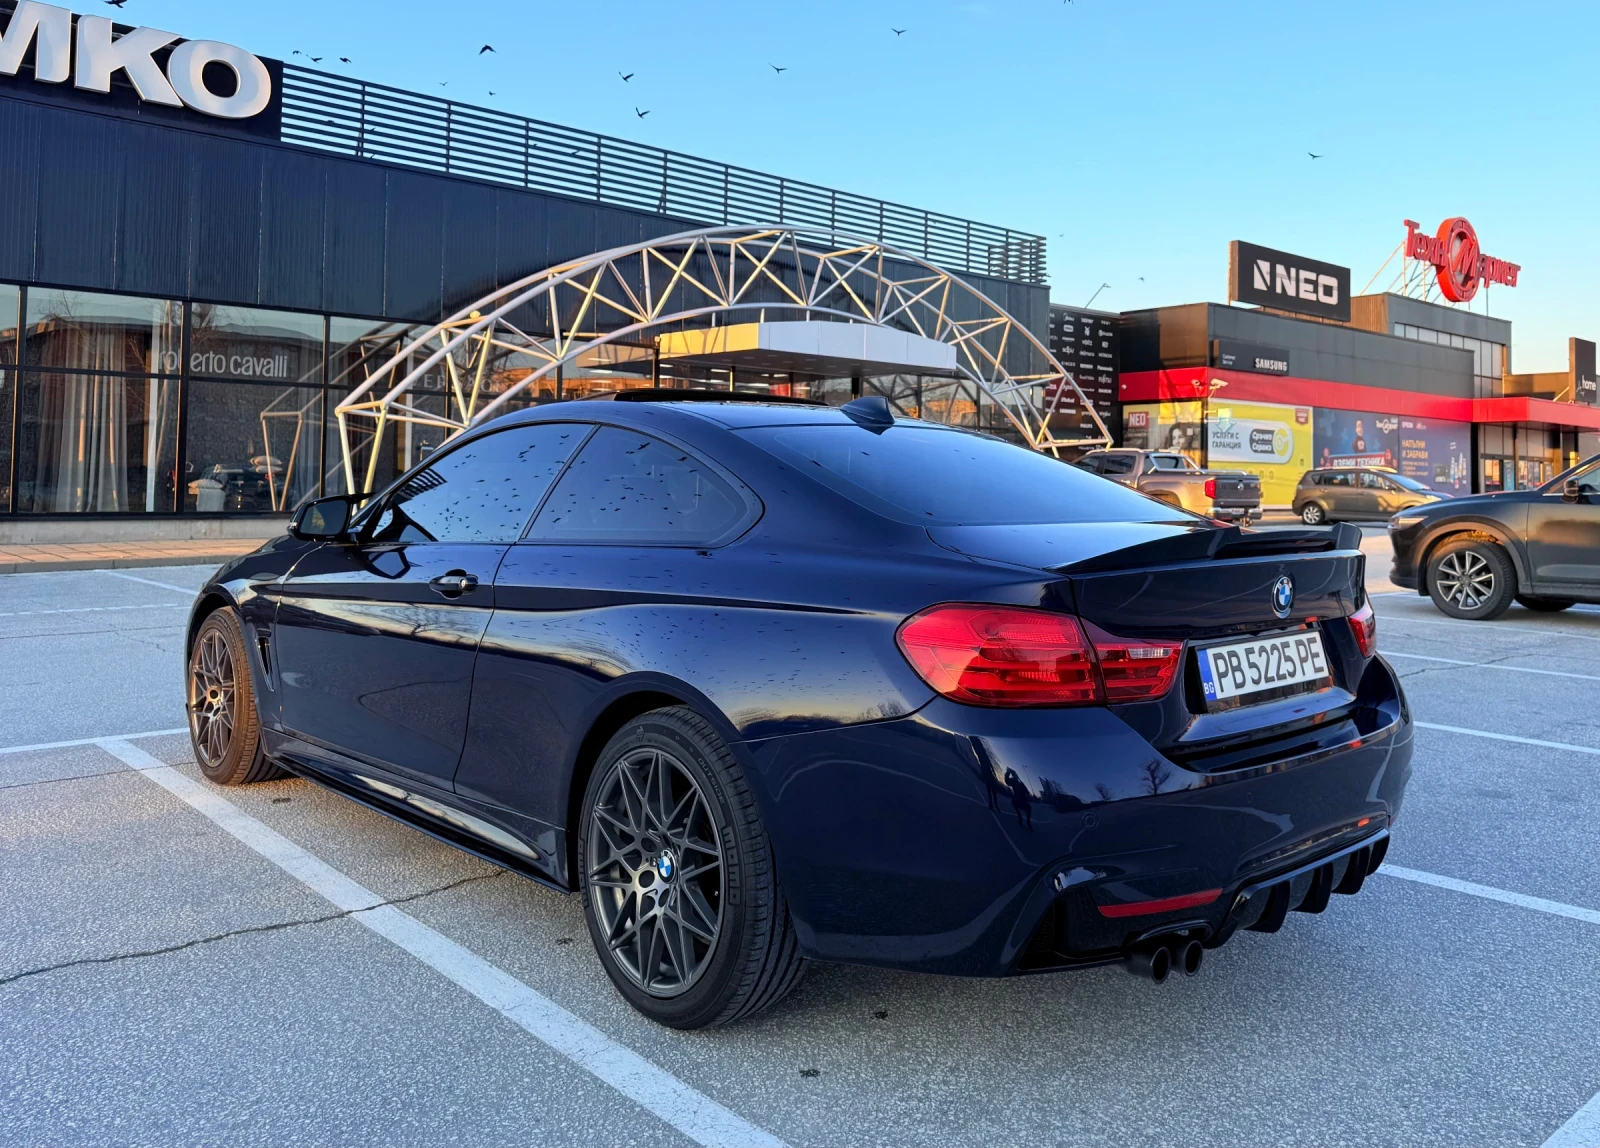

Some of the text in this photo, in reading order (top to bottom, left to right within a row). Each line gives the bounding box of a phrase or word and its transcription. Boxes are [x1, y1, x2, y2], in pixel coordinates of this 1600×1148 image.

[1275, 263, 1338, 305] NEO
[159, 348, 287, 378] roerto cavalli
[1255, 358, 1288, 371] SAMSUNG
[1129, 413, 1146, 426] NEO
[1212, 431, 1235, 439] УСЛУГИ
[1212, 441, 1242, 450] ГАРАНЦИЯ
[1212, 637, 1324, 693] PB 5225 PE
[1203, 682, 1215, 695] BG
